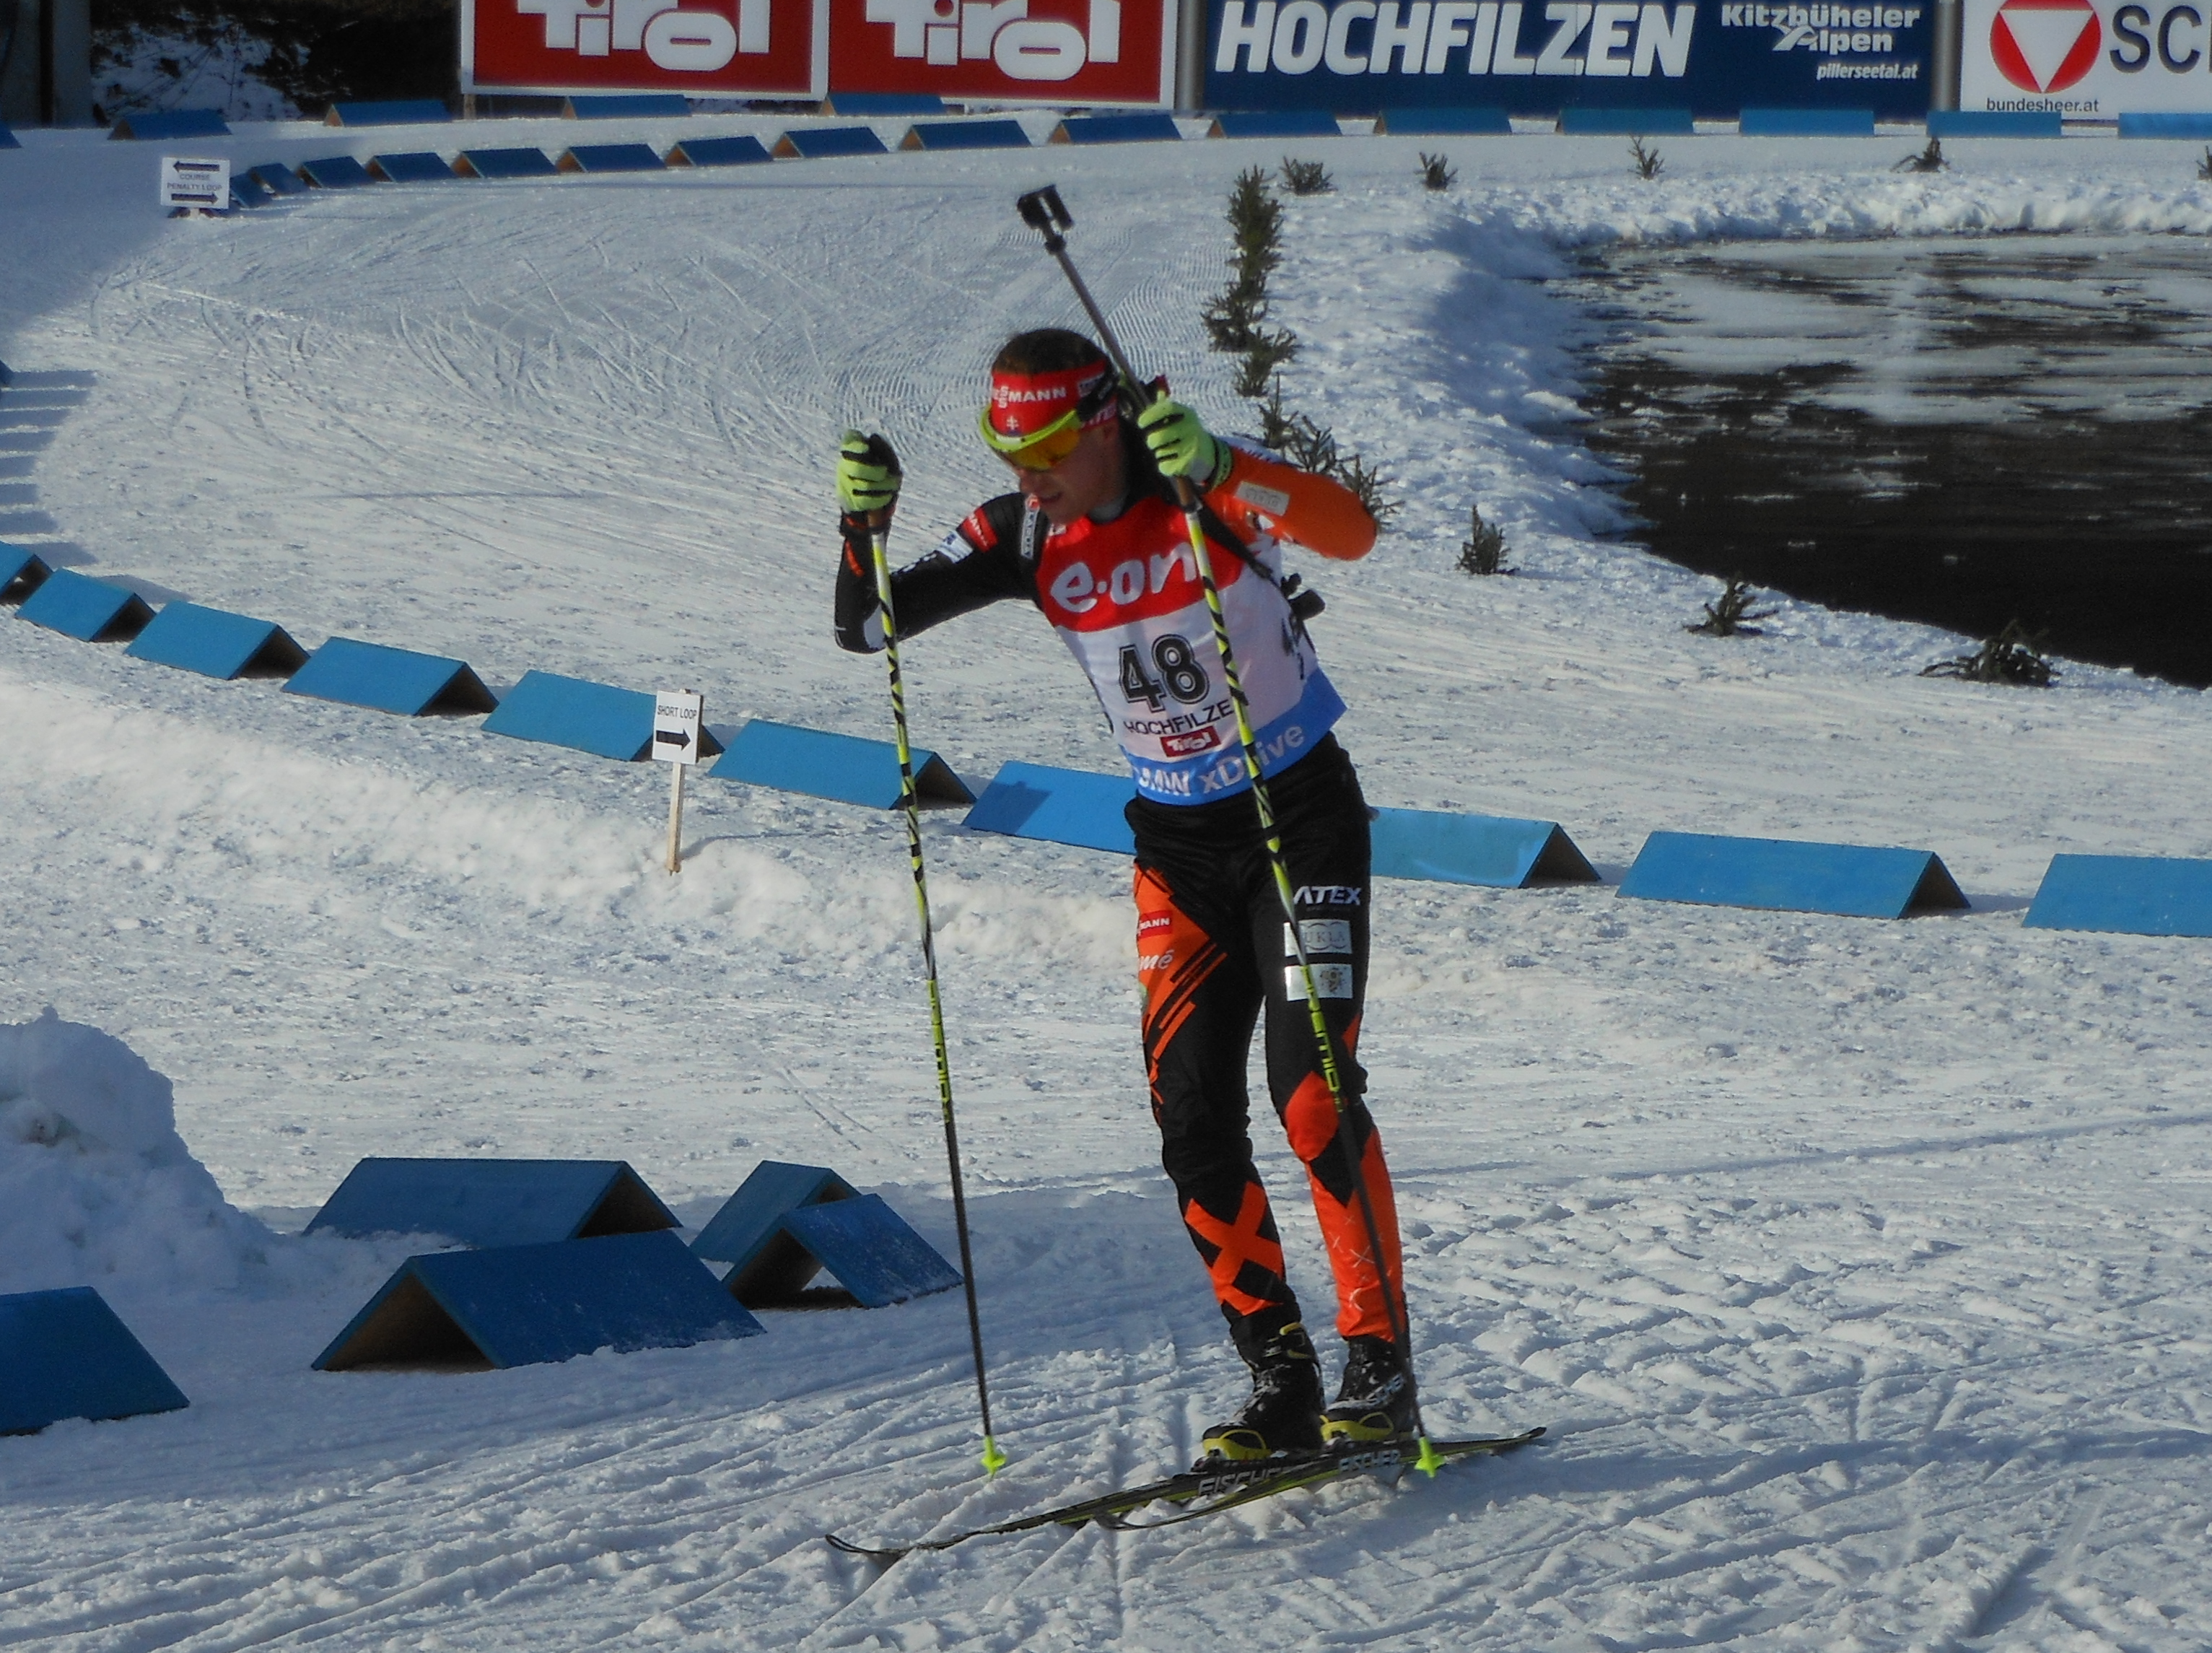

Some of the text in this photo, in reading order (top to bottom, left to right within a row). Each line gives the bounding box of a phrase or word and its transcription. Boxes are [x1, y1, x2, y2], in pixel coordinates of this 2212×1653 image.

[1721, 4, 1920, 28] Kitzbüheler
[1215, 0, 1696, 76] HOCHFILZEN
[2110, 4, 2212, 74] SC
[1816, 63, 1918, 80] pillerseetal.at
[1986, 97, 2099, 113] bundesheer.at
[1119, 634, 1210, 712] 48
[657, 705, 697, 720] SHORT LOOP
[1123, 699, 1236, 735] HOCHFILZE
[1200, 726, 1305, 793] xDive
